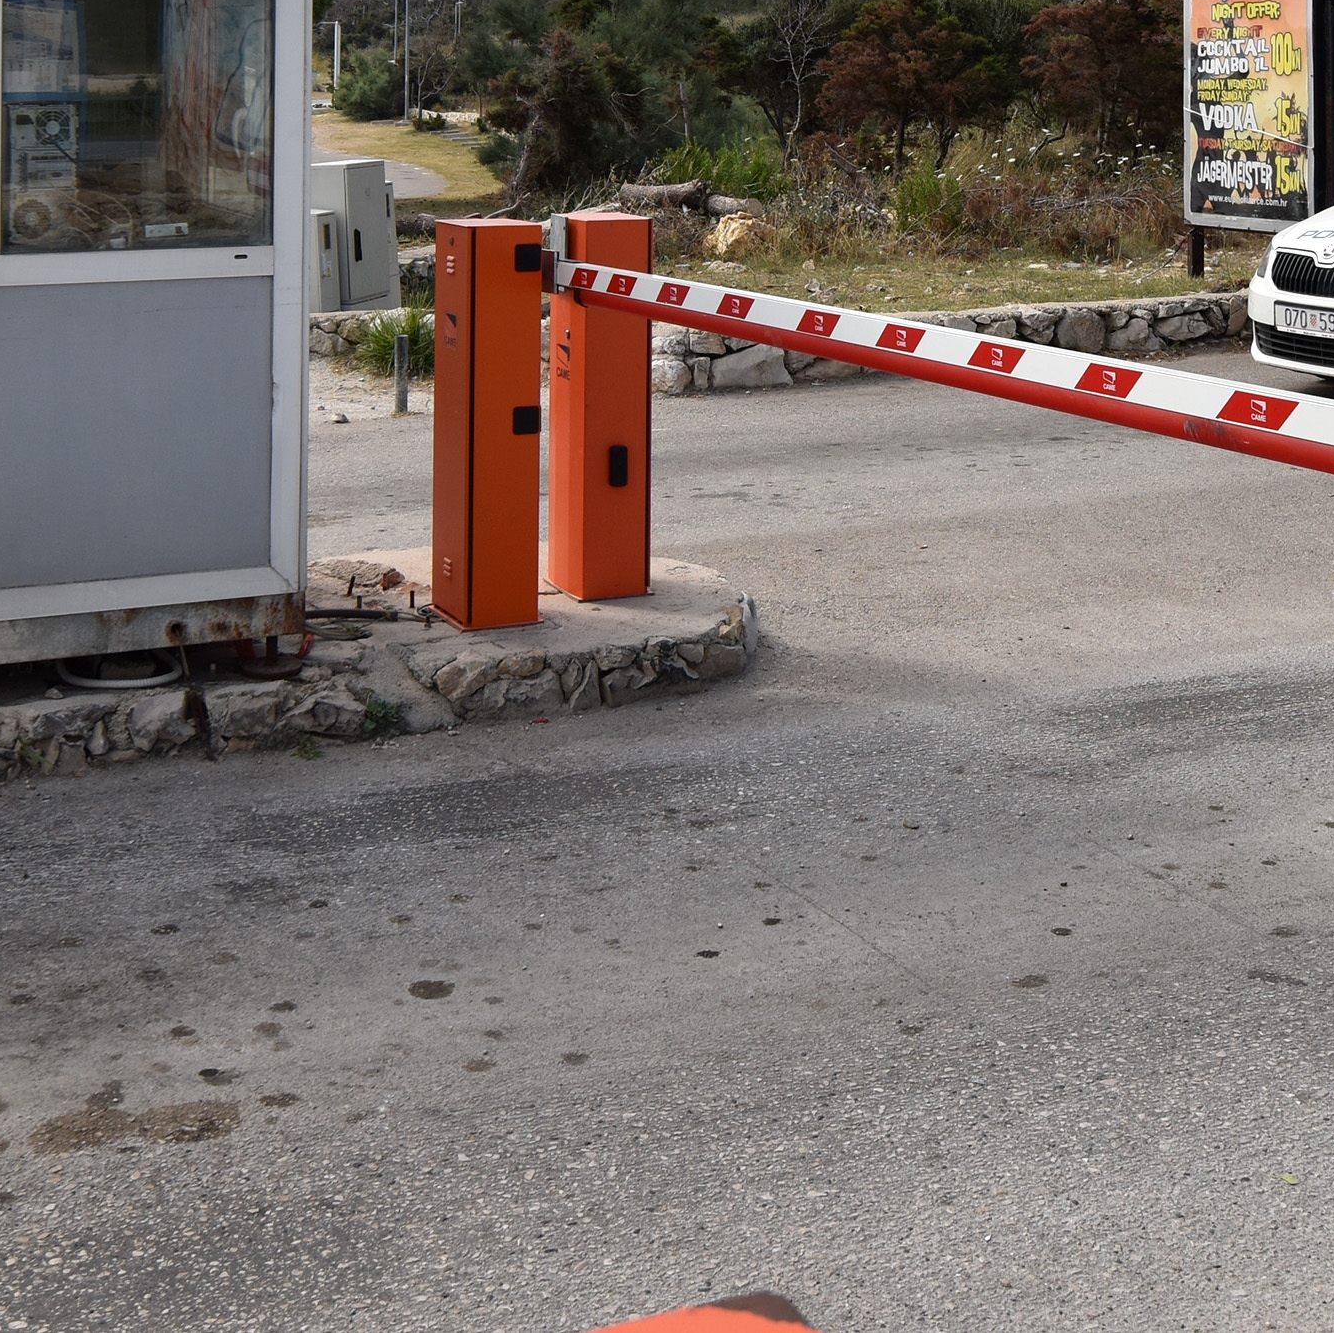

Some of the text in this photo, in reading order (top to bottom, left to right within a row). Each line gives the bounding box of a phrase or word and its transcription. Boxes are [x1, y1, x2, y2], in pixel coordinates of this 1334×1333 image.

[1212, 2, 1245, 22] NIGHT
[1197, 25, 1263, 40] EVERY NIGHT
[1197, 38, 1270, 57] COCKTAIL
[1197, 57, 1269, 75] JUMBO 1L
[1198, 101, 1258, 132] VODKA
[1197, 155, 1273, 191] JÄGERMEISTER
[1284, 308, 1308, 328] 070
[1250, 413, 1267, 422] CAME
